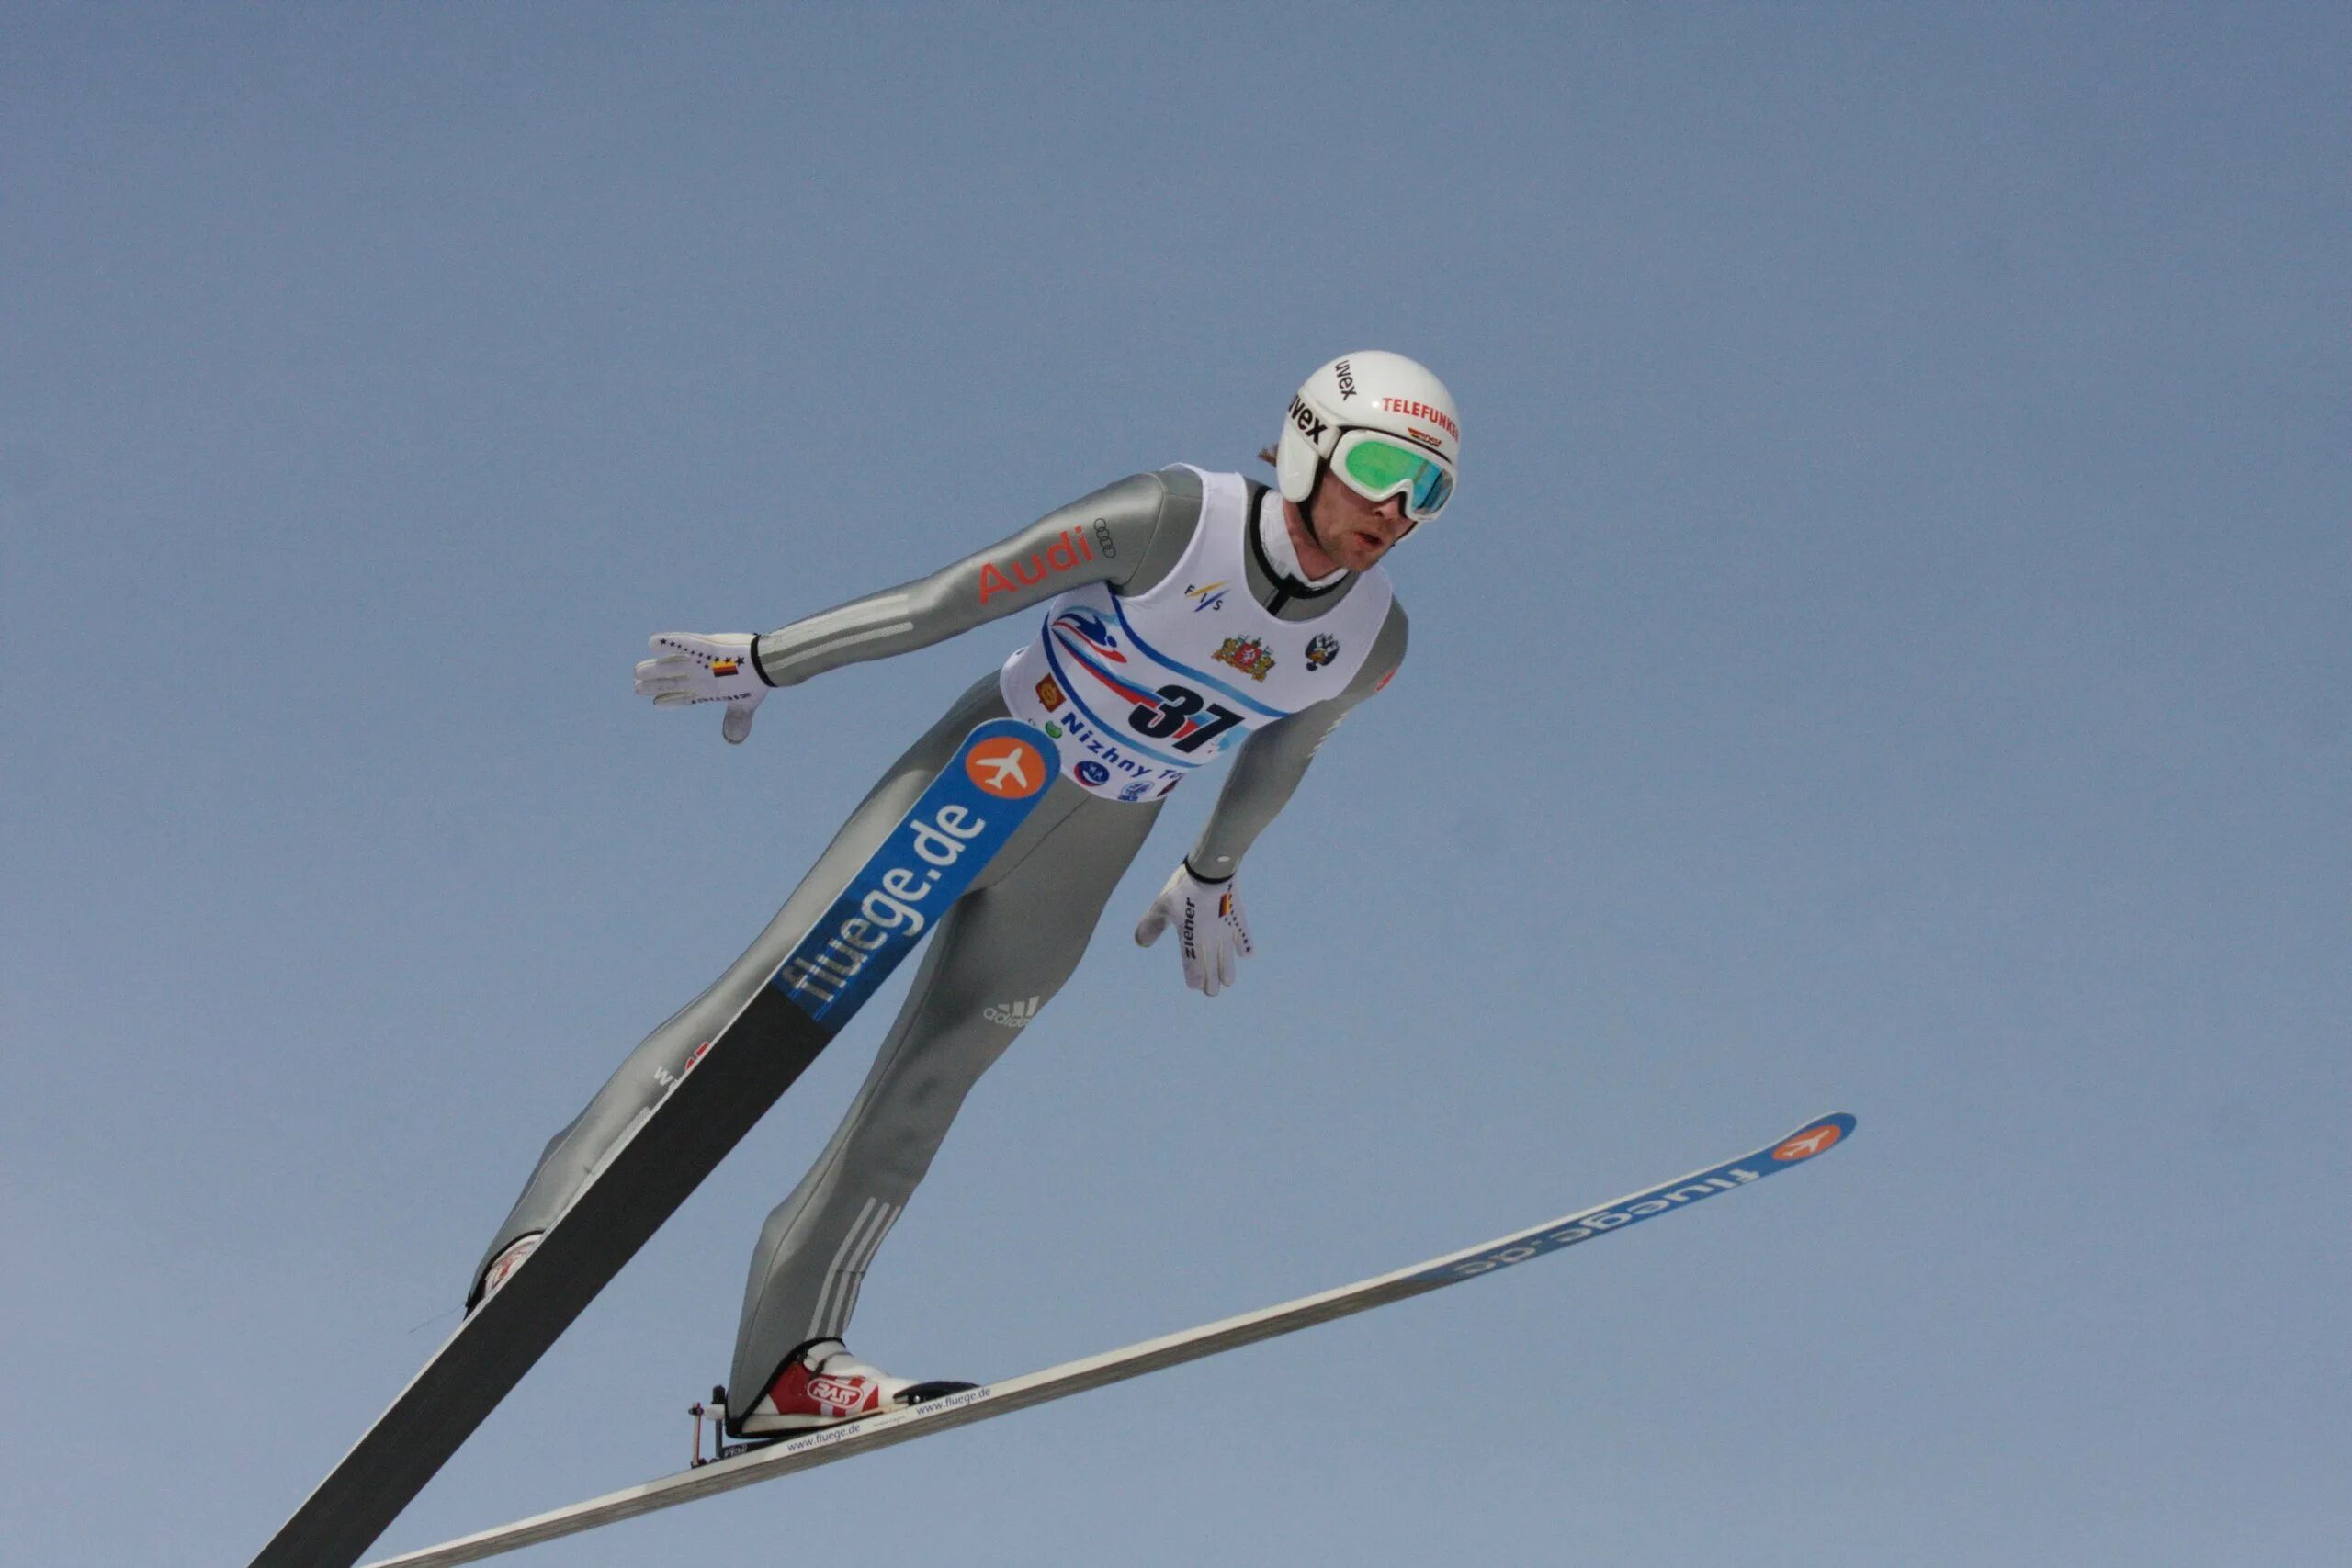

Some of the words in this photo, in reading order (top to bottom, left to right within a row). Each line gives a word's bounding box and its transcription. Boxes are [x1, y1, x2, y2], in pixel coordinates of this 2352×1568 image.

[1335, 359, 1357, 401] uvex
[978, 525, 1094, 604] Audi
[1061, 712, 1152, 778] Nizhny
[1128, 684, 1245, 754] 37
[781, 803, 986, 1003] fluege.de
[1183, 897, 1197, 960] ziener
[1454, 1167, 1760, 1276] fluege.de
[916, 1387, 991, 1415] www.fluege.de
[786, 1424, 861, 1451] www.fluege.de
